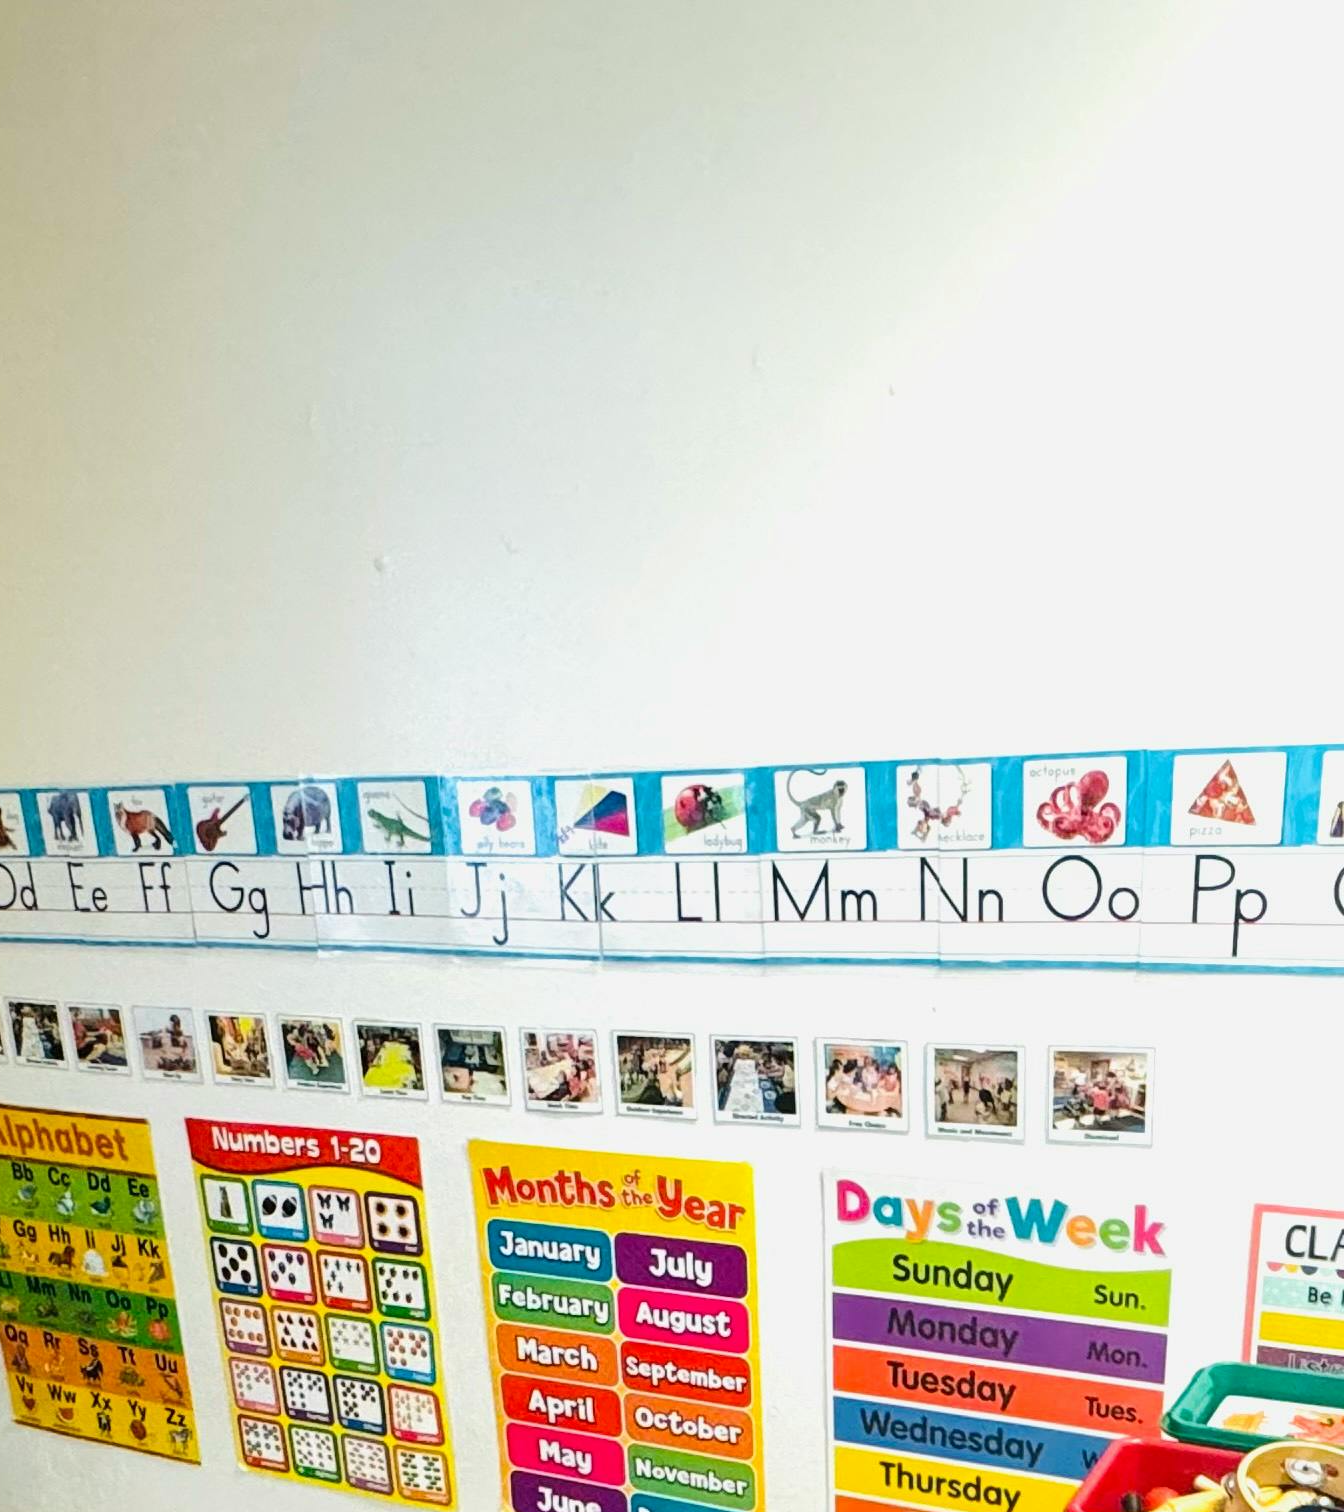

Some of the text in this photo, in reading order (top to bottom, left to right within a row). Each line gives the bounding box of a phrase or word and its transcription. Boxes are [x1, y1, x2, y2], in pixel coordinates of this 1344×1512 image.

[1029, 766, 1076, 783] octopus
[809, 834, 852, 848] monkey
[1189, 824, 1223, 839] pizza
[68, 861, 108, 913] Ee
[138, 861, 173, 913] Ff
[209, 861, 271, 938] Gg
[297, 860, 354, 916] Hh
[384, 860, 415, 917] Ii
[460, 862, 510, 946] Jj
[558, 862, 618, 923] Kk
[674, 861, 722, 923] Ll
[771, 860, 878, 923] Mm
[919, 856, 1005, 923] Nn
[1041, 854, 1140, 922] Oo
[1191, 854, 1268, 957] Pp
[210, 1126, 381, 1164] Numbers 1-20
[11, 1161, 34, 1182] Bb
[48, 1167, 71, 1187] Cc
[87, 1172, 111, 1194] Dd
[127, 1178, 150, 1199] Ee
[482, 1166, 747, 1231] Months of the Year
[836, 1179, 1167, 1257] Days of the Week
[13, 1220, 38, 1243] Gg
[48, 1226, 71, 1247] Hh
[85, 1230, 97, 1250] Ii
[111, 1234, 127, 1258] Jj
[137, 1238, 161, 1259] Kk
[499, 1230, 601, 1271] January
[649, 1249, 713, 1288] July
[892, 1254, 1146, 1311] Sunday Sun.
[498, 1284, 610, 1324] February
[1307, 1286, 1333, 1305] Be
[635, 1302, 732, 1339] August
[887, 1307, 1148, 1370] Monday Mon.
[78, 1338, 100, 1359] Ss
[516, 1336, 599, 1372] March
[624, 1355, 747, 1393] September
[887, 1360, 1144, 1424] Tuesday Tues.
[47, 1384, 186, 1428] Ww Xx Zz
[528, 1388, 595, 1424] April
[634, 1409, 743, 1444] October
[859, 1408, 1044, 1469] Wednesday
[538, 1438, 594, 1475] May
[634, 1457, 749, 1497] November
